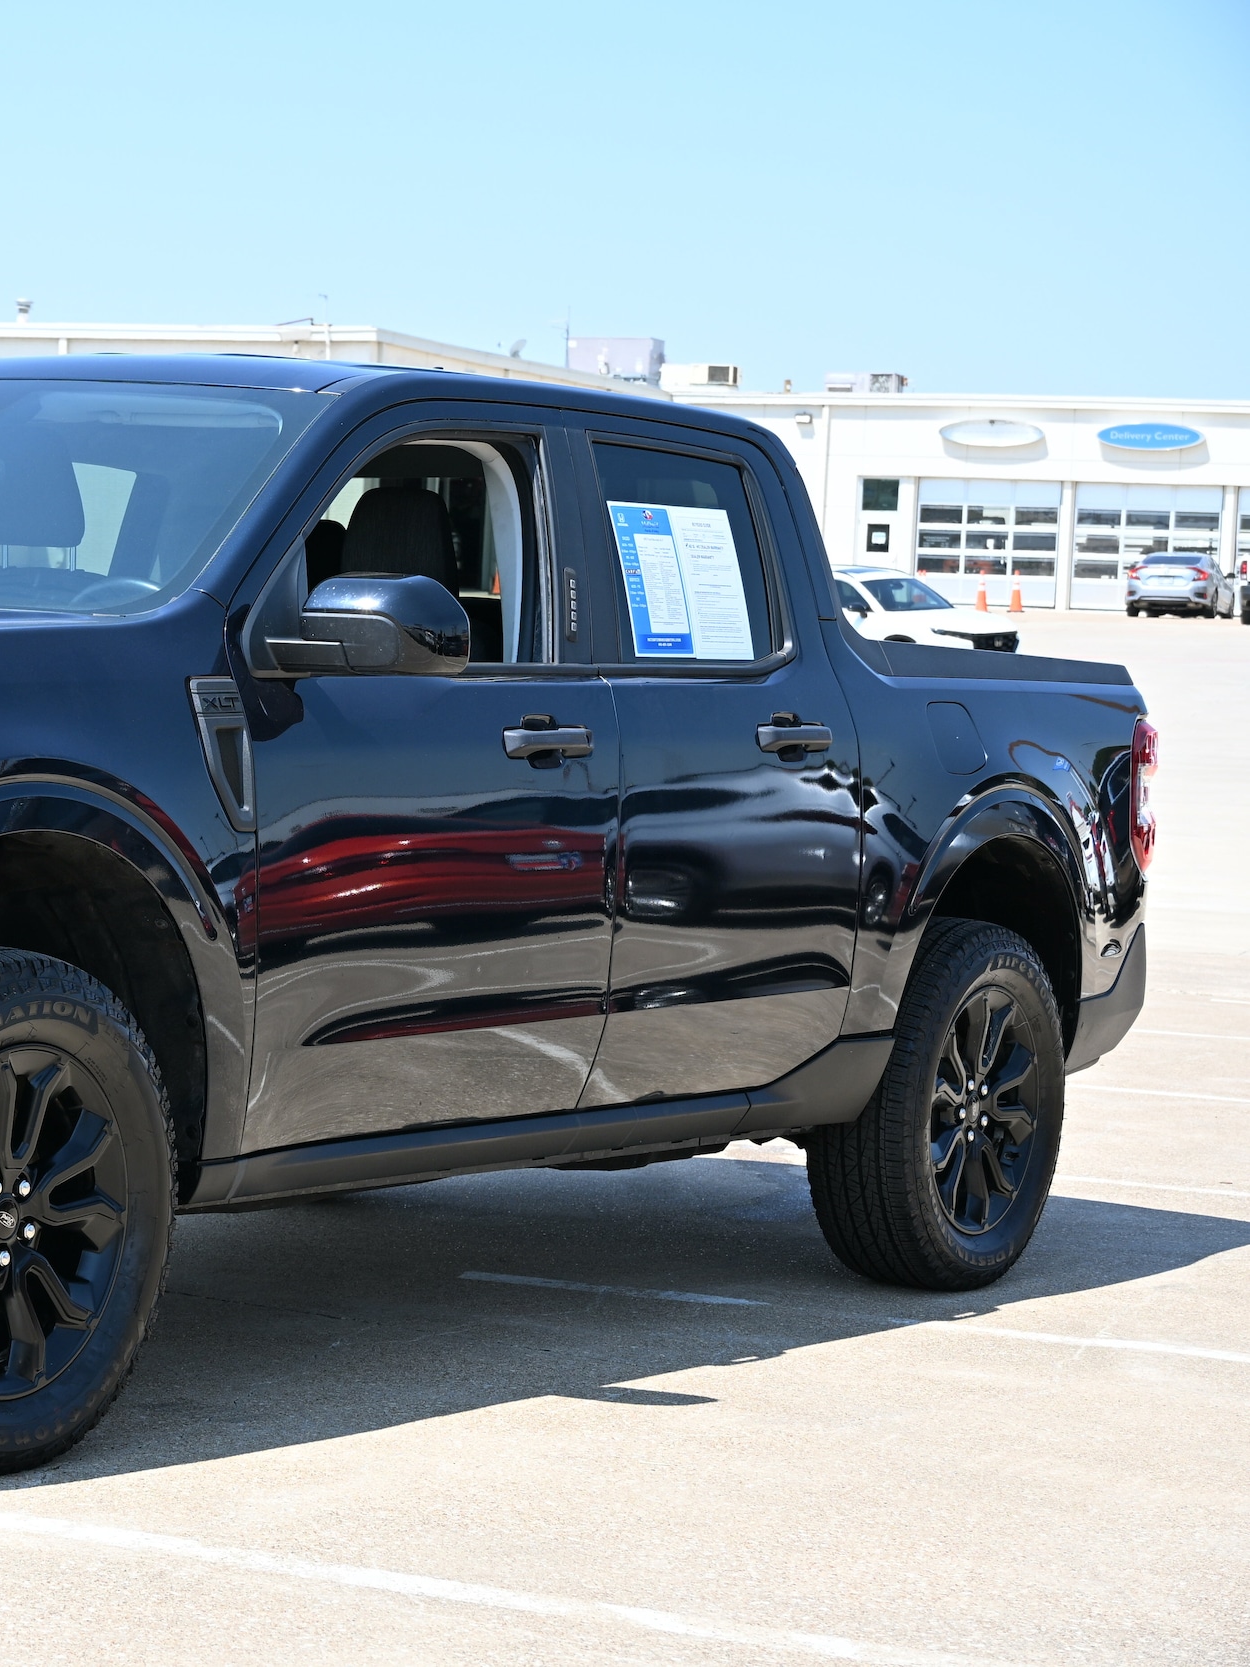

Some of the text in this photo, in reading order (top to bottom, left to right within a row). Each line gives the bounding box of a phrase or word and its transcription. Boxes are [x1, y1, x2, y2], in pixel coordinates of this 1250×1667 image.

[1109, 430, 1190, 443] Delivery Center
[202, 696, 240, 711] XLT
